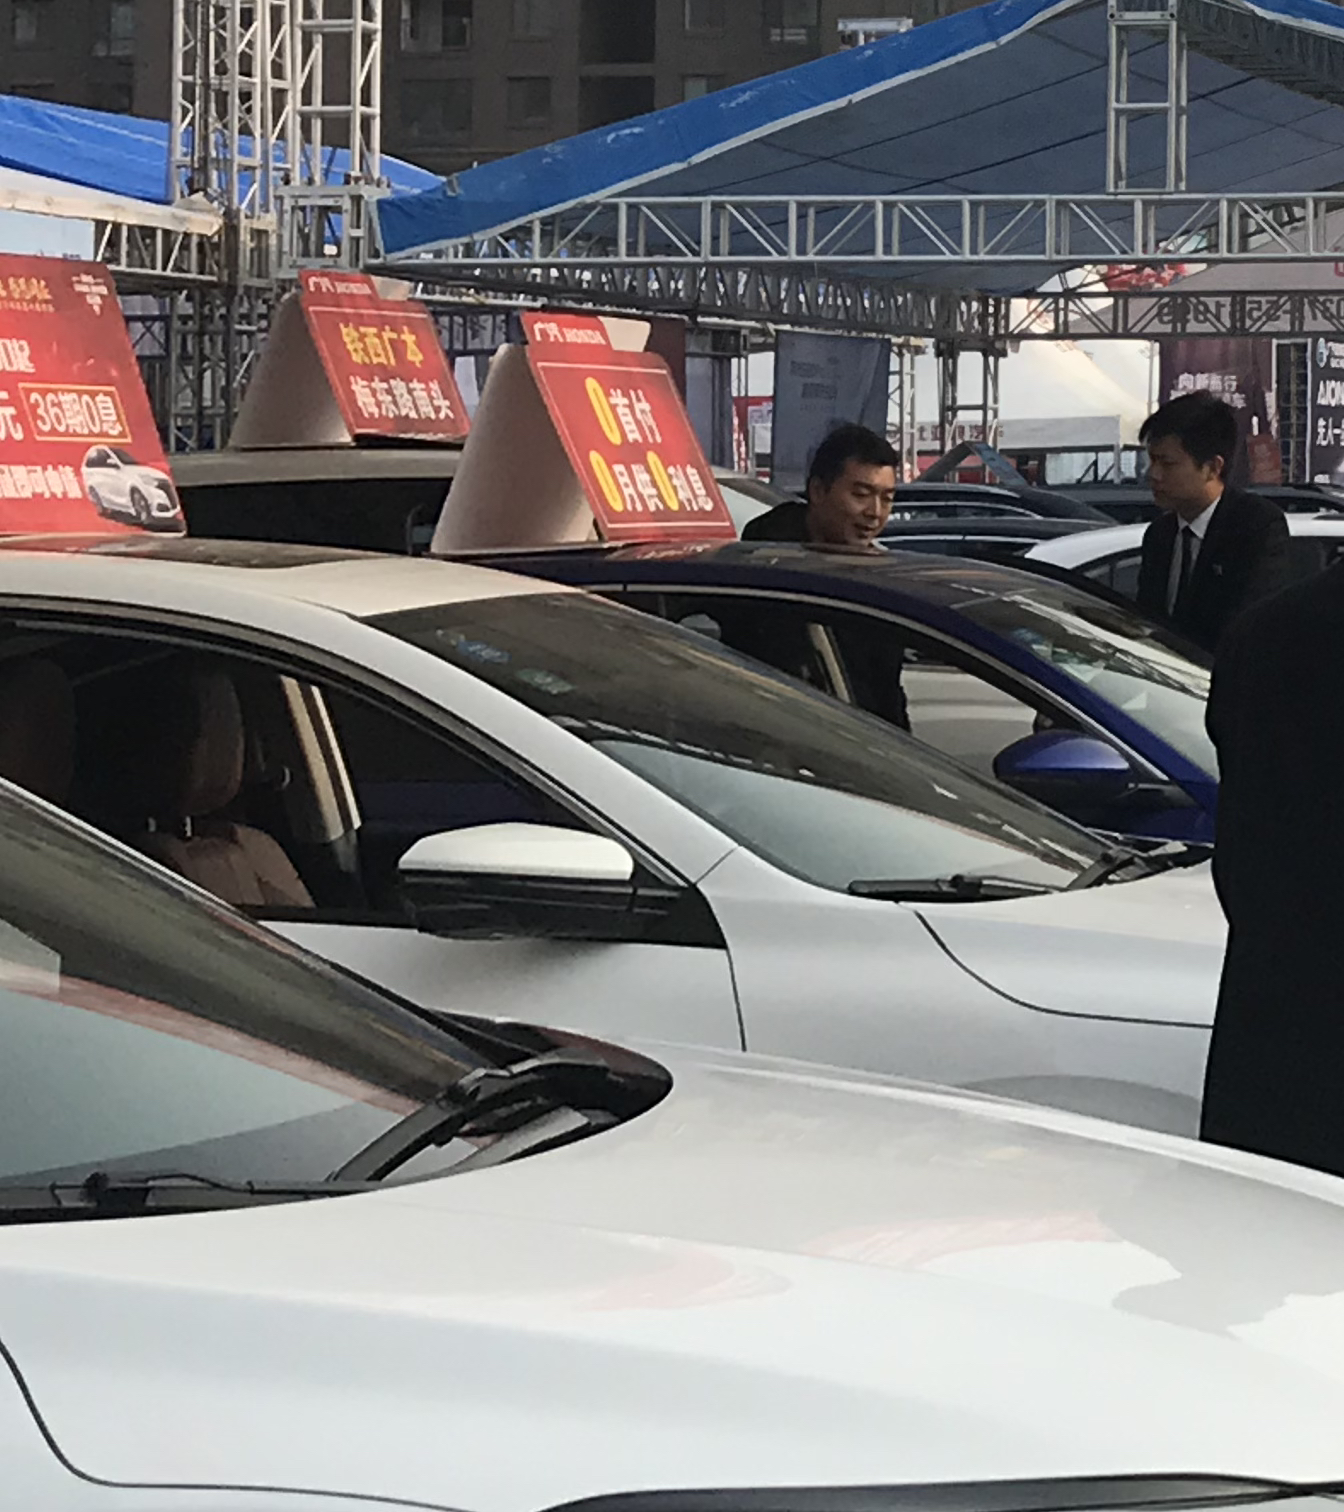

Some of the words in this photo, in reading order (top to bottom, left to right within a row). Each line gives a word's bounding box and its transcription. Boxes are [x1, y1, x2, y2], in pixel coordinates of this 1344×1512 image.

[29, 392, 123, 436] 36期0息
[585, 377, 662, 445] 0首付
[589, 450, 714, 513] 0月供0利息
